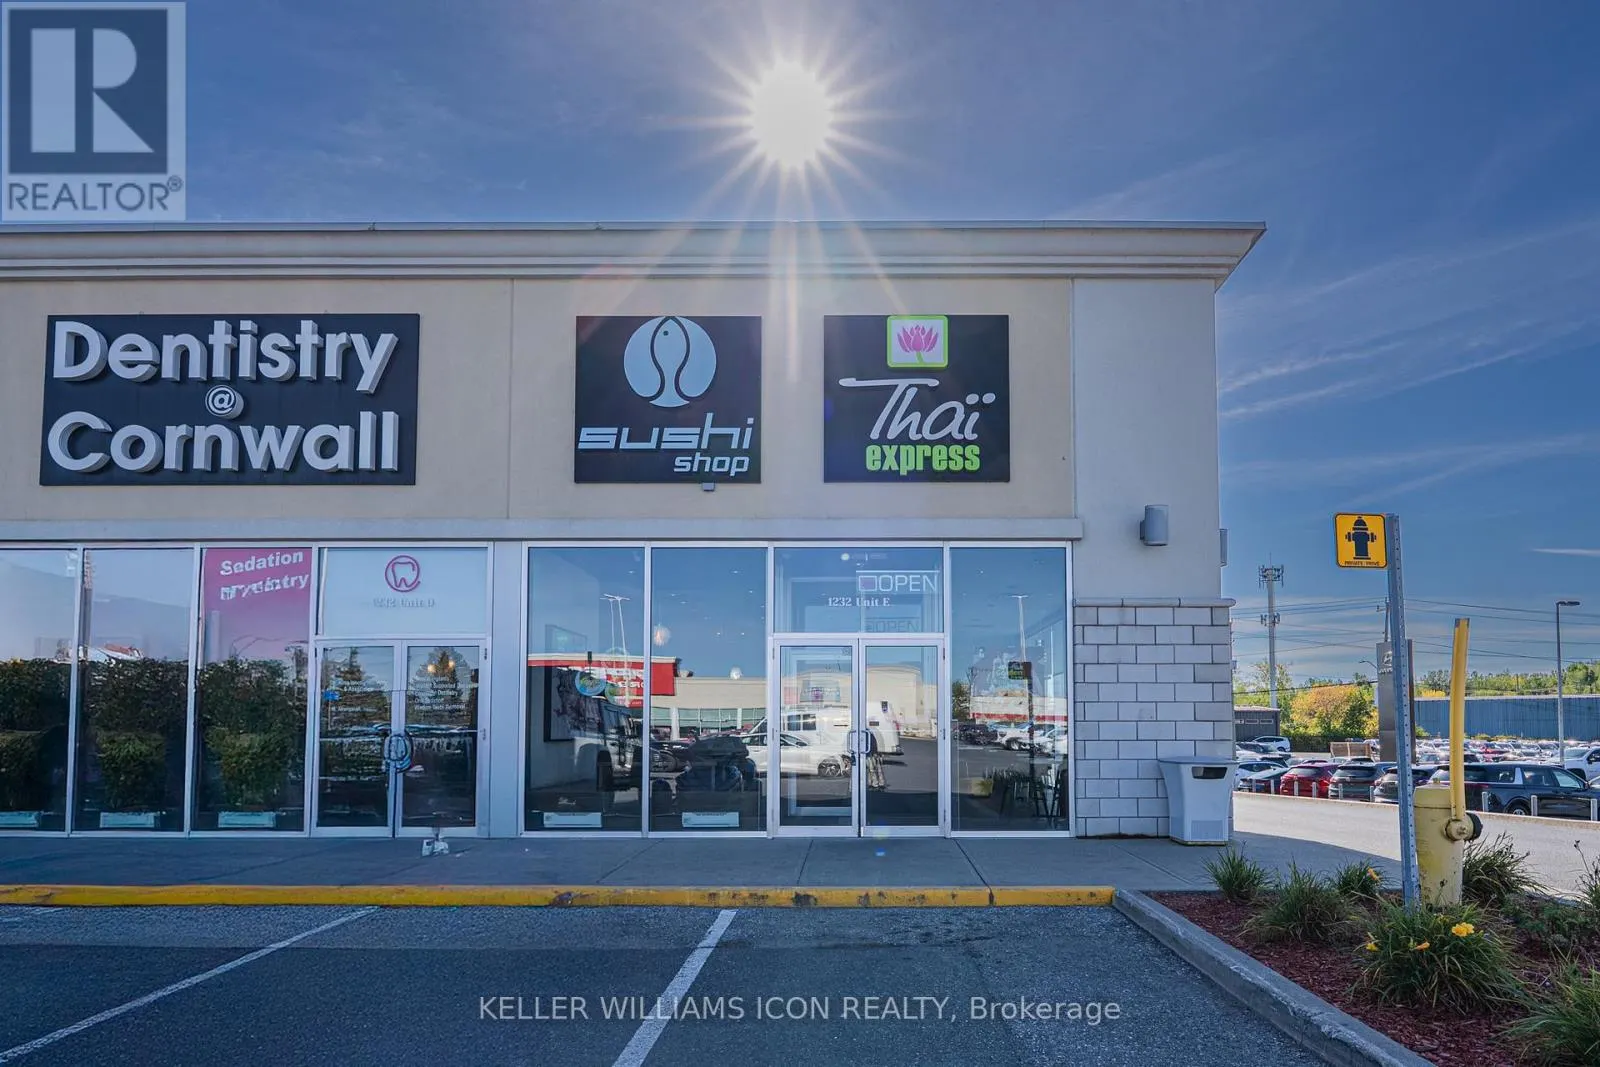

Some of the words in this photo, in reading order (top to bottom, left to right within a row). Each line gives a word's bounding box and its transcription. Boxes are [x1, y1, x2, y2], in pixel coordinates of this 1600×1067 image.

[53, 320, 399, 394] Dentistry
[205, 384, 244, 420] @
[838, 377, 996, 441] Thaï
[48, 411, 399, 472] Cornwall
[578, 412, 755, 450] sushi
[673, 452, 750, 477] shop
[865, 444, 981, 476] express
[220, 551, 304, 576] Sedation
[878, 574, 938, 592] OPEN
[828, 597, 853, 607] 1232
[856, 597, 880, 607] Unit
[882, 597, 891, 607] E
